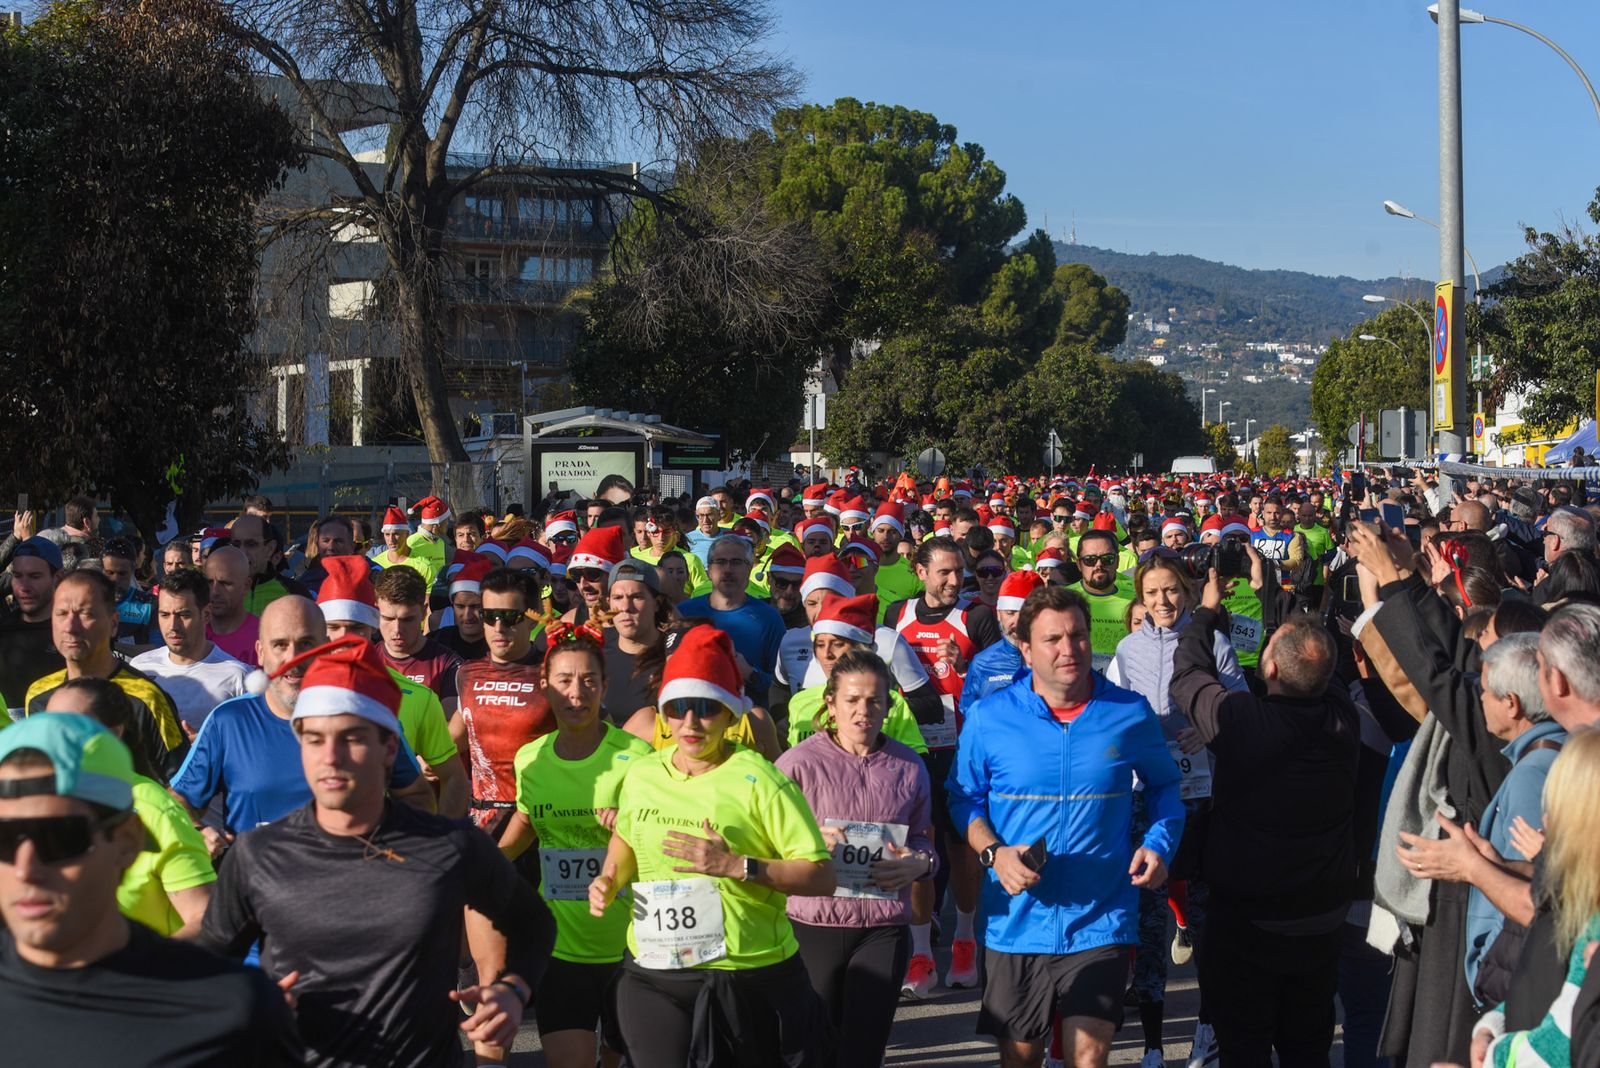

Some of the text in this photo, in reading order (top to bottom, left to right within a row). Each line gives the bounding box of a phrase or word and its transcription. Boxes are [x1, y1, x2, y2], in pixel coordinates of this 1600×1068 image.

[555, 460, 591, 468] PRADA
[1230, 623, 1256, 639] 1543
[473, 681, 535, 693] LOBOS
[475, 695, 527, 707] TRAIL
[842, 844, 884, 866] 604
[558, 858, 601, 880] 979
[653, 906, 697, 932] 138
